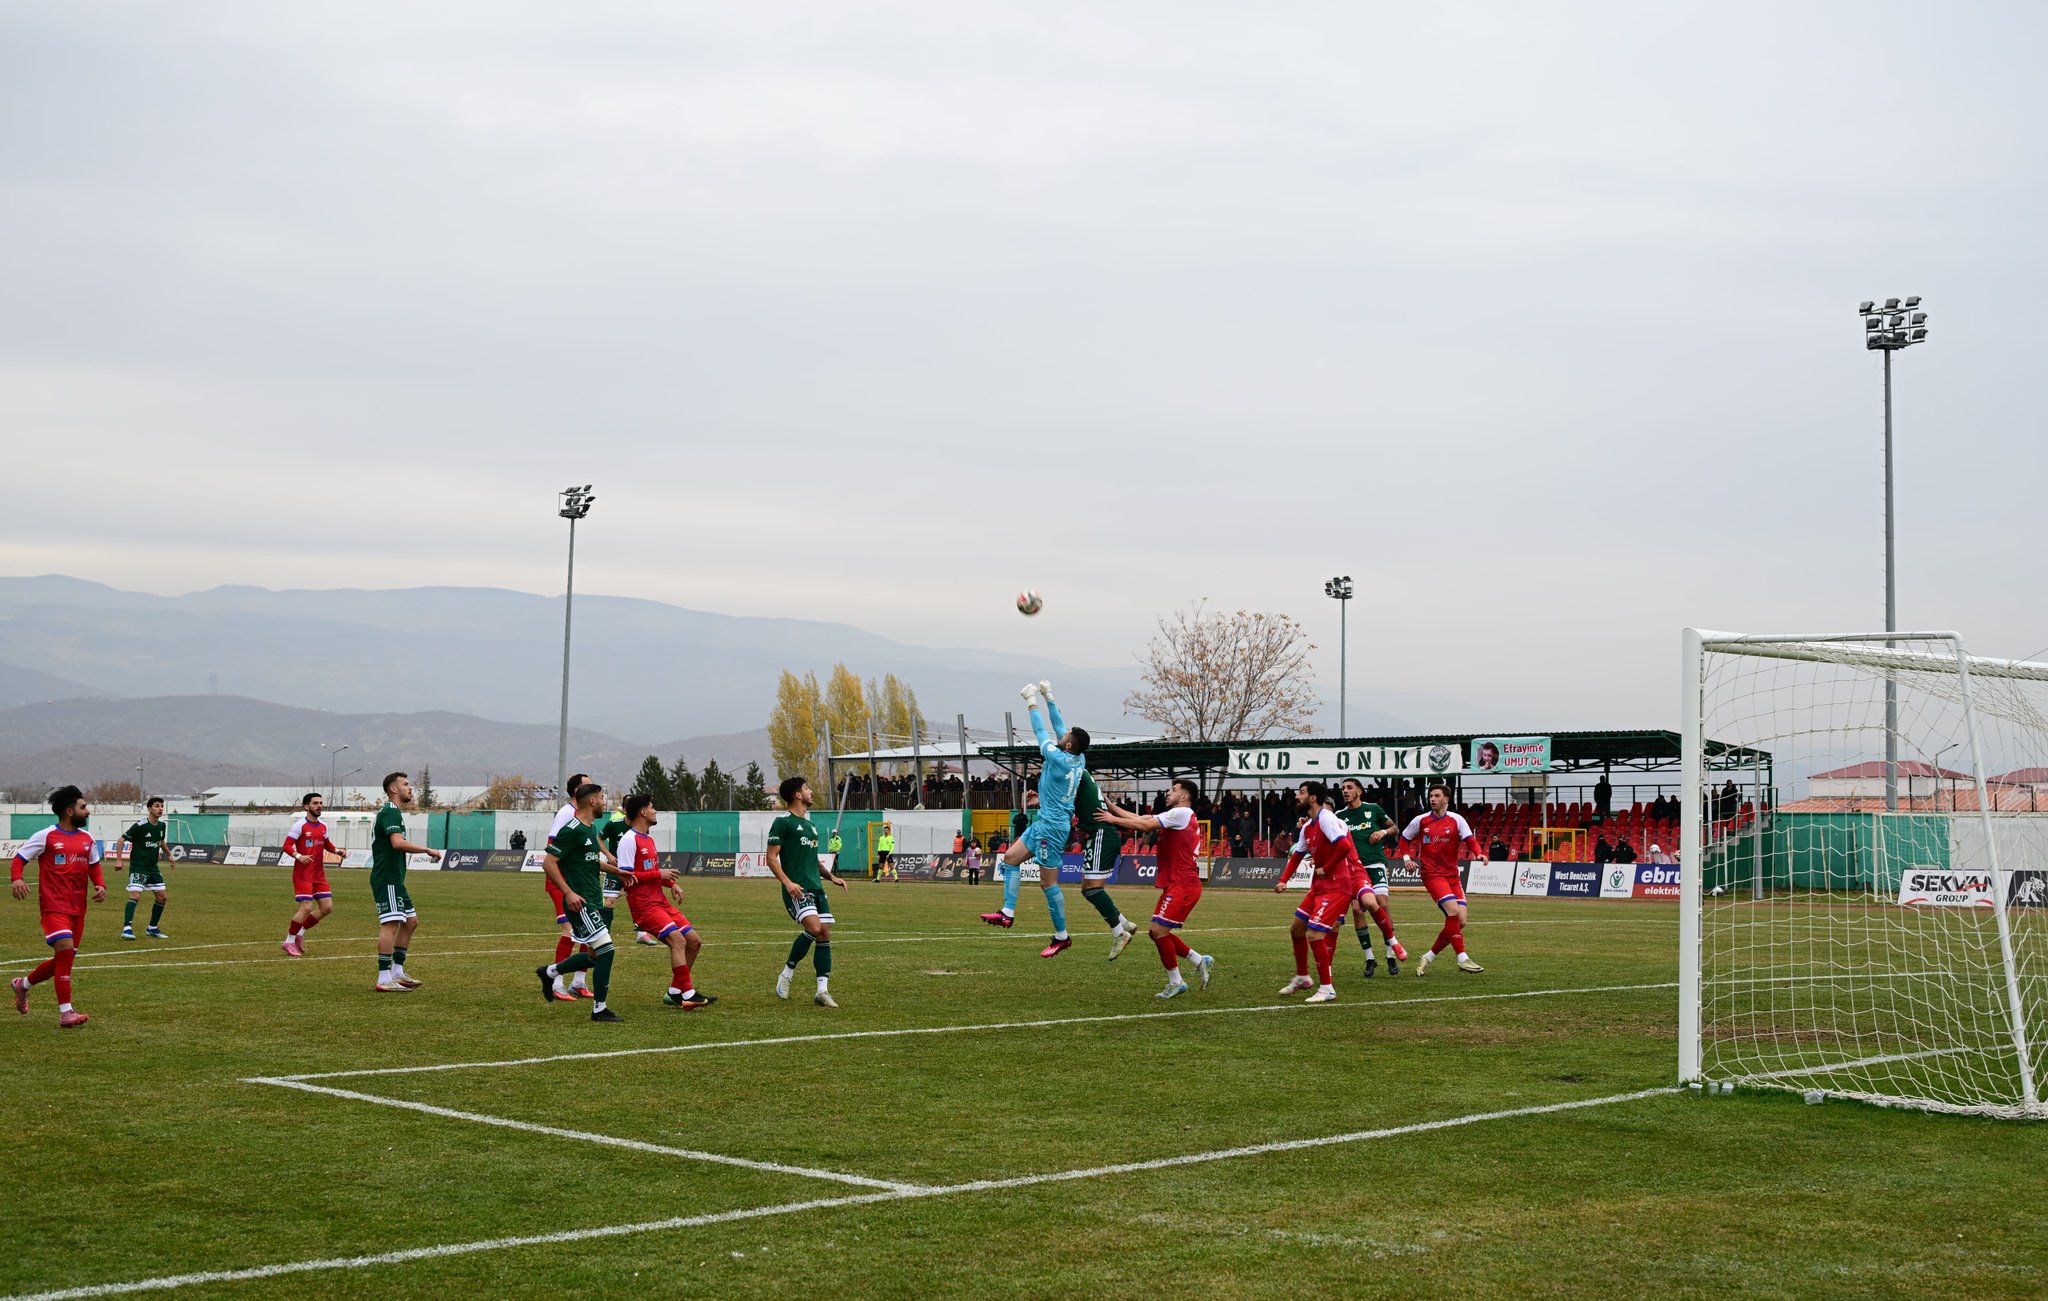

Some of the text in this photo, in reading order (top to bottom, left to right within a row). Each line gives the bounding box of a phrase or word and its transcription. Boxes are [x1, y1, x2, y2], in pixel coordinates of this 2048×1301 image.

[1503, 743, 1544, 754] Efrayim'e
[1238, 751, 1291, 771] KOD
[1336, 746, 1422, 771] ONİKİ
[1504, 757, 1542, 767] UMUT OL
[1040, 849, 1048, 860] 13
[1020, 868, 1040, 878] ENİZC
[1138, 865, 1158, 877] ca
[1238, 867, 1280, 875] BURSAB
[1529, 872, 1546, 880] West
[1555, 871, 1596, 880] West Denizcilik
[1641, 867, 1680, 884] ebru
[1527, 881, 1545, 889] Ships
[1560, 882, 1579, 891] Ticaret
[1644, 886, 1680, 895] elektrik
[1935, 894, 1968, 903] GROUP
[1317, 907, 1325, 917] 4
